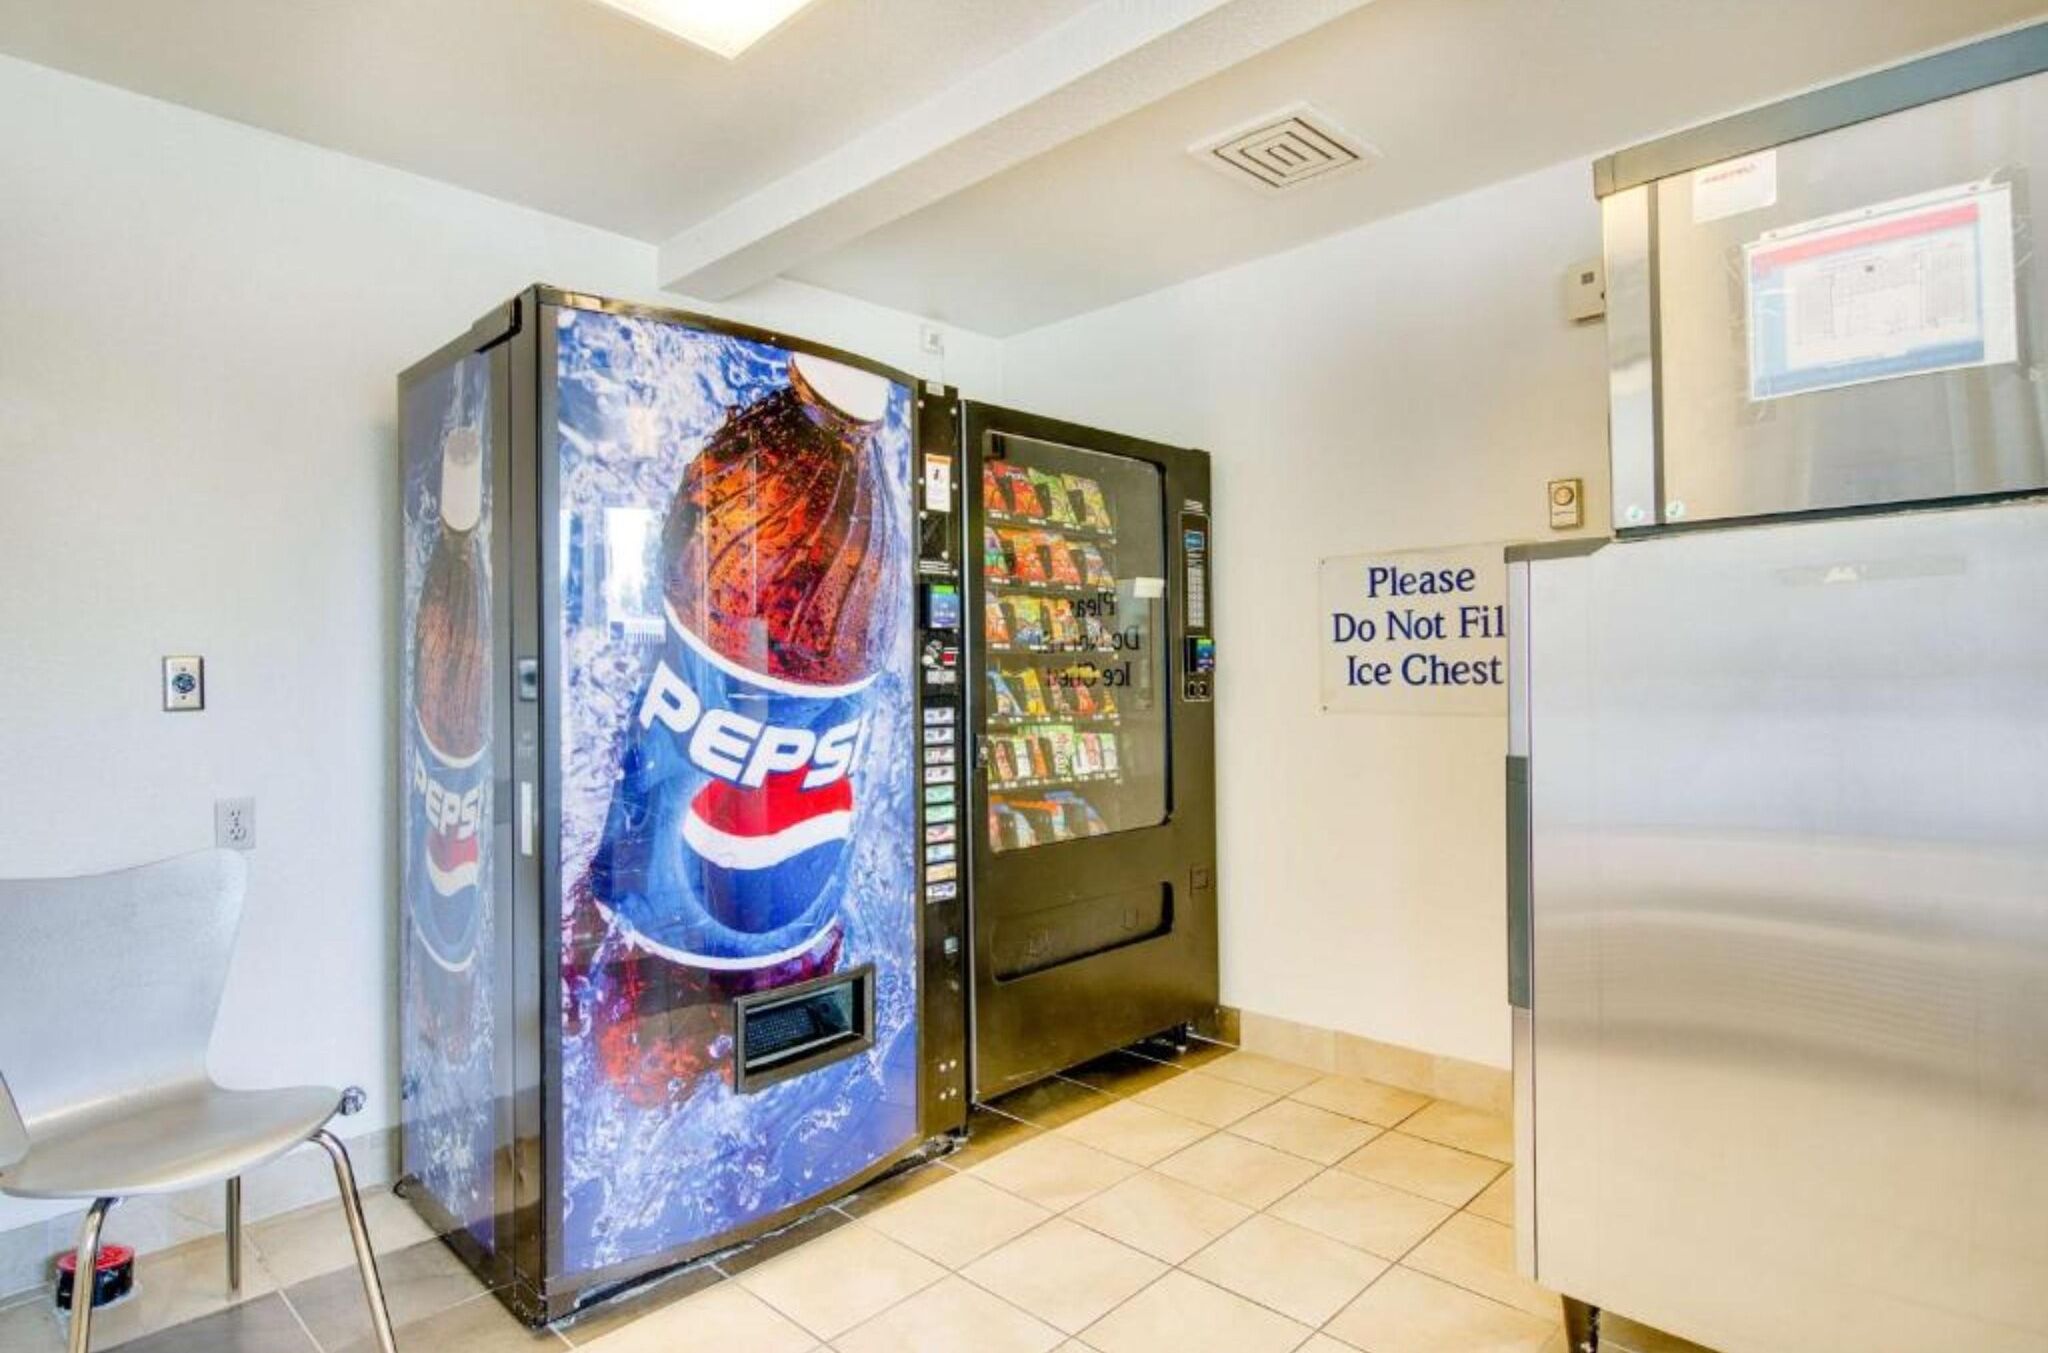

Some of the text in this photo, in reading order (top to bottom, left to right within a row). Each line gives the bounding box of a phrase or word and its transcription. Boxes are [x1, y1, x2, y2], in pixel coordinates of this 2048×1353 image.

[1367, 566, 1476, 598] Please
[1332, 605, 1507, 643] Do Not Fil
[1346, 653, 1505, 687] Ice Chest
[639, 661, 871, 790] PEPSI
